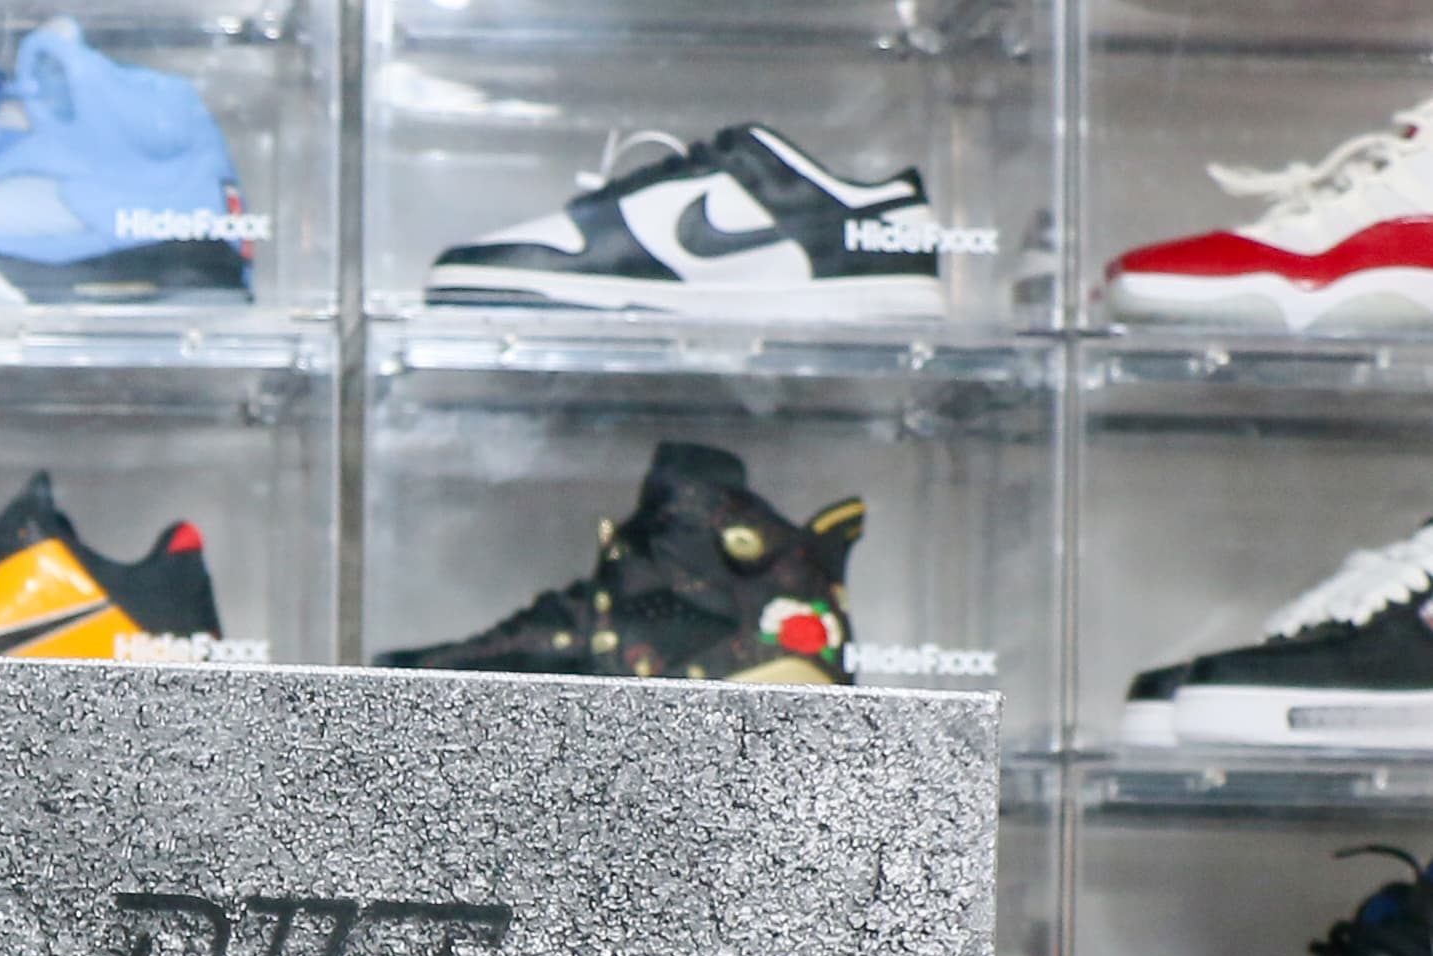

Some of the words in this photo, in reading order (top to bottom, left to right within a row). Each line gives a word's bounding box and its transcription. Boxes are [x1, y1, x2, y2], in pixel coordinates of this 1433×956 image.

[116, 207, 270, 241] HideFxxx
[844, 218, 998, 254] HideFxxx
[114, 632, 269, 663] HideFxxx
[843, 642, 997, 676] HideFxxx
